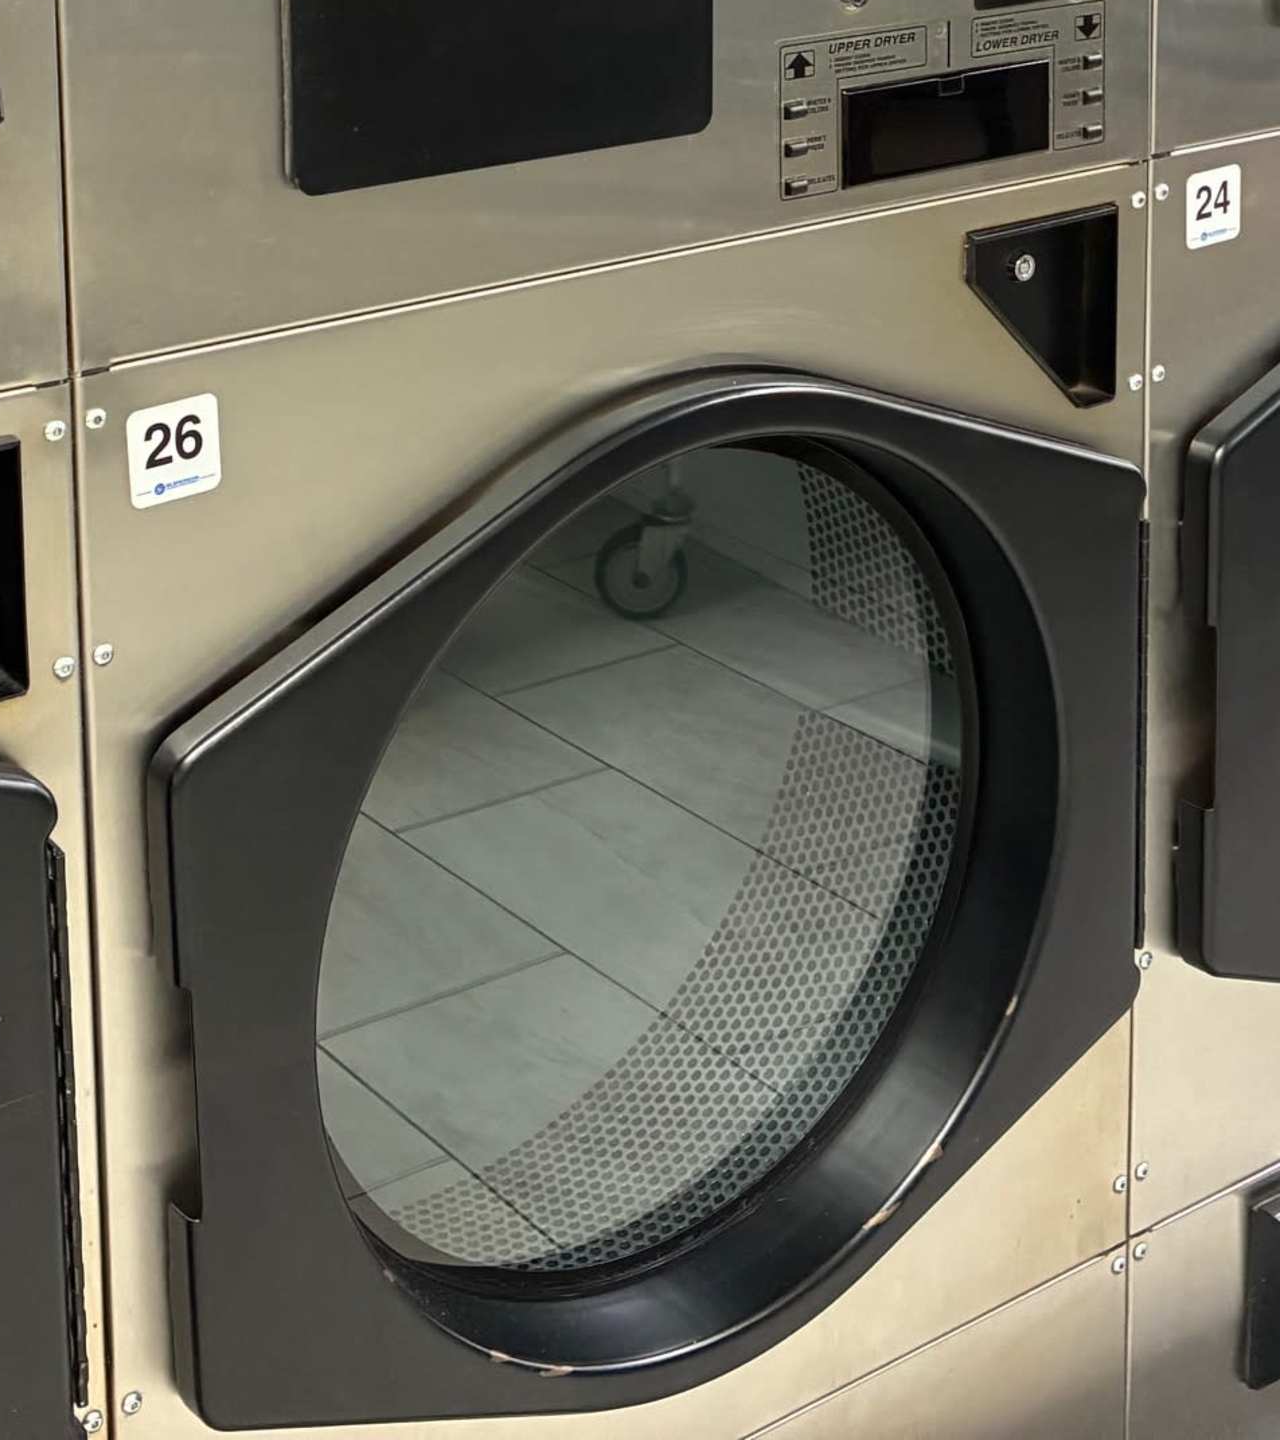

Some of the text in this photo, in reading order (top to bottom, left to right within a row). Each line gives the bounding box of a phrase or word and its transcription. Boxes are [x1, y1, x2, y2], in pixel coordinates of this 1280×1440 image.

[829, 32, 916, 54] UPPER DRYER
[976, 30, 1060, 52] LOWER DRYER
[1195, 180, 1231, 221] 24
[144, 413, 204, 470] 26
